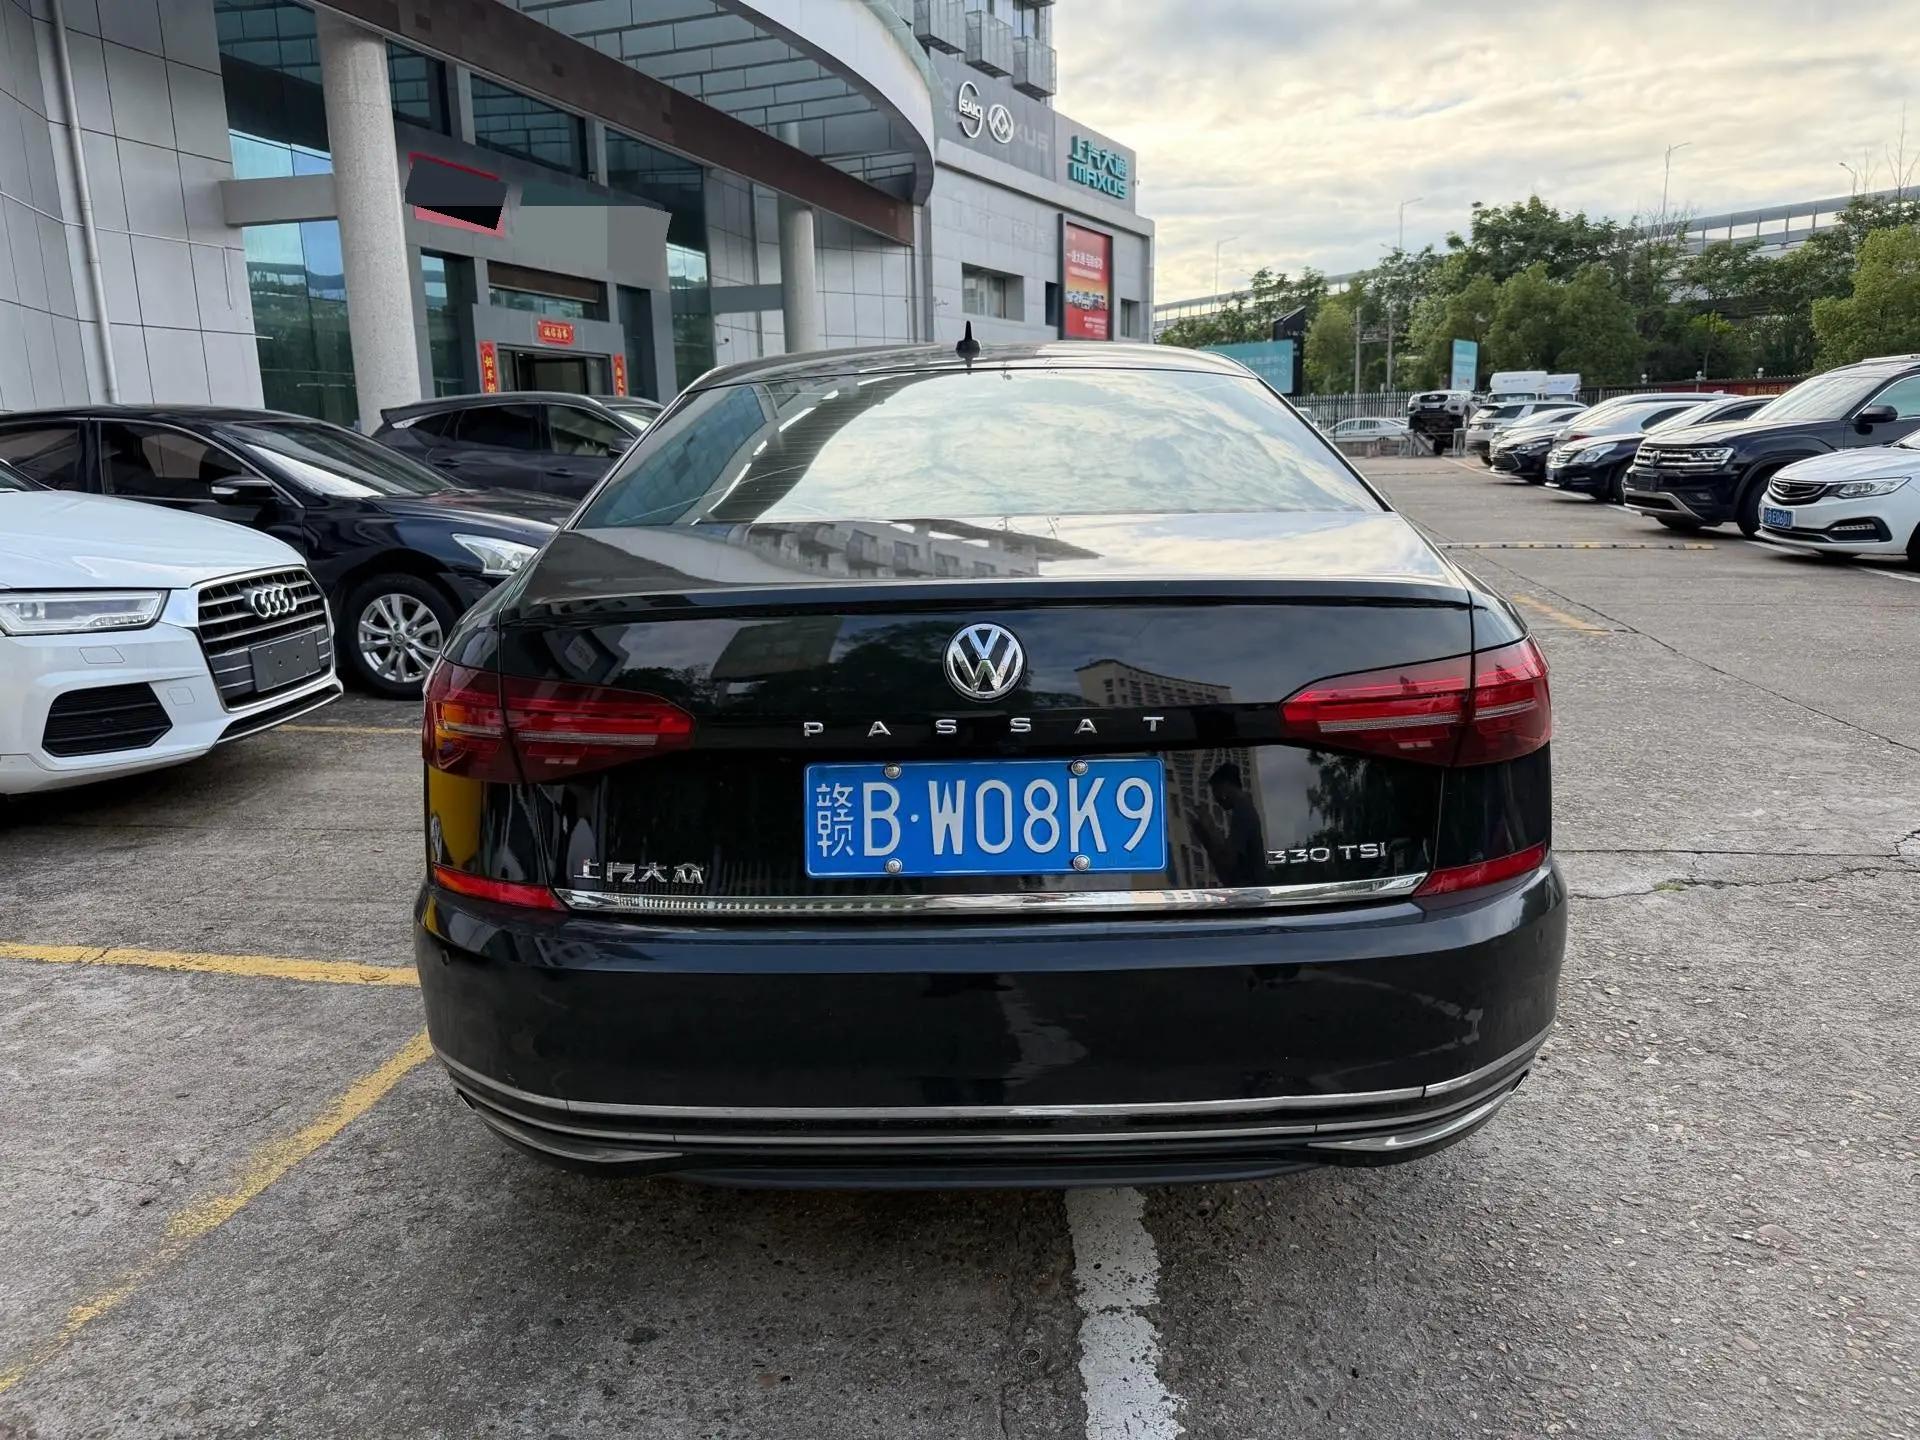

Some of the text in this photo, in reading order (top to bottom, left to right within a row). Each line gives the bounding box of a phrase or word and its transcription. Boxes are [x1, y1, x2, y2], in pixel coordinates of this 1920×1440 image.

[1069, 136, 1127, 180] 上汽大通
[1069, 162, 1127, 199] MAXUS
[803, 716, 1165, 737] PASSAT
[1266, 841, 1386, 865] 330 TSI
[574, 858, 704, 884] 上汽大众
